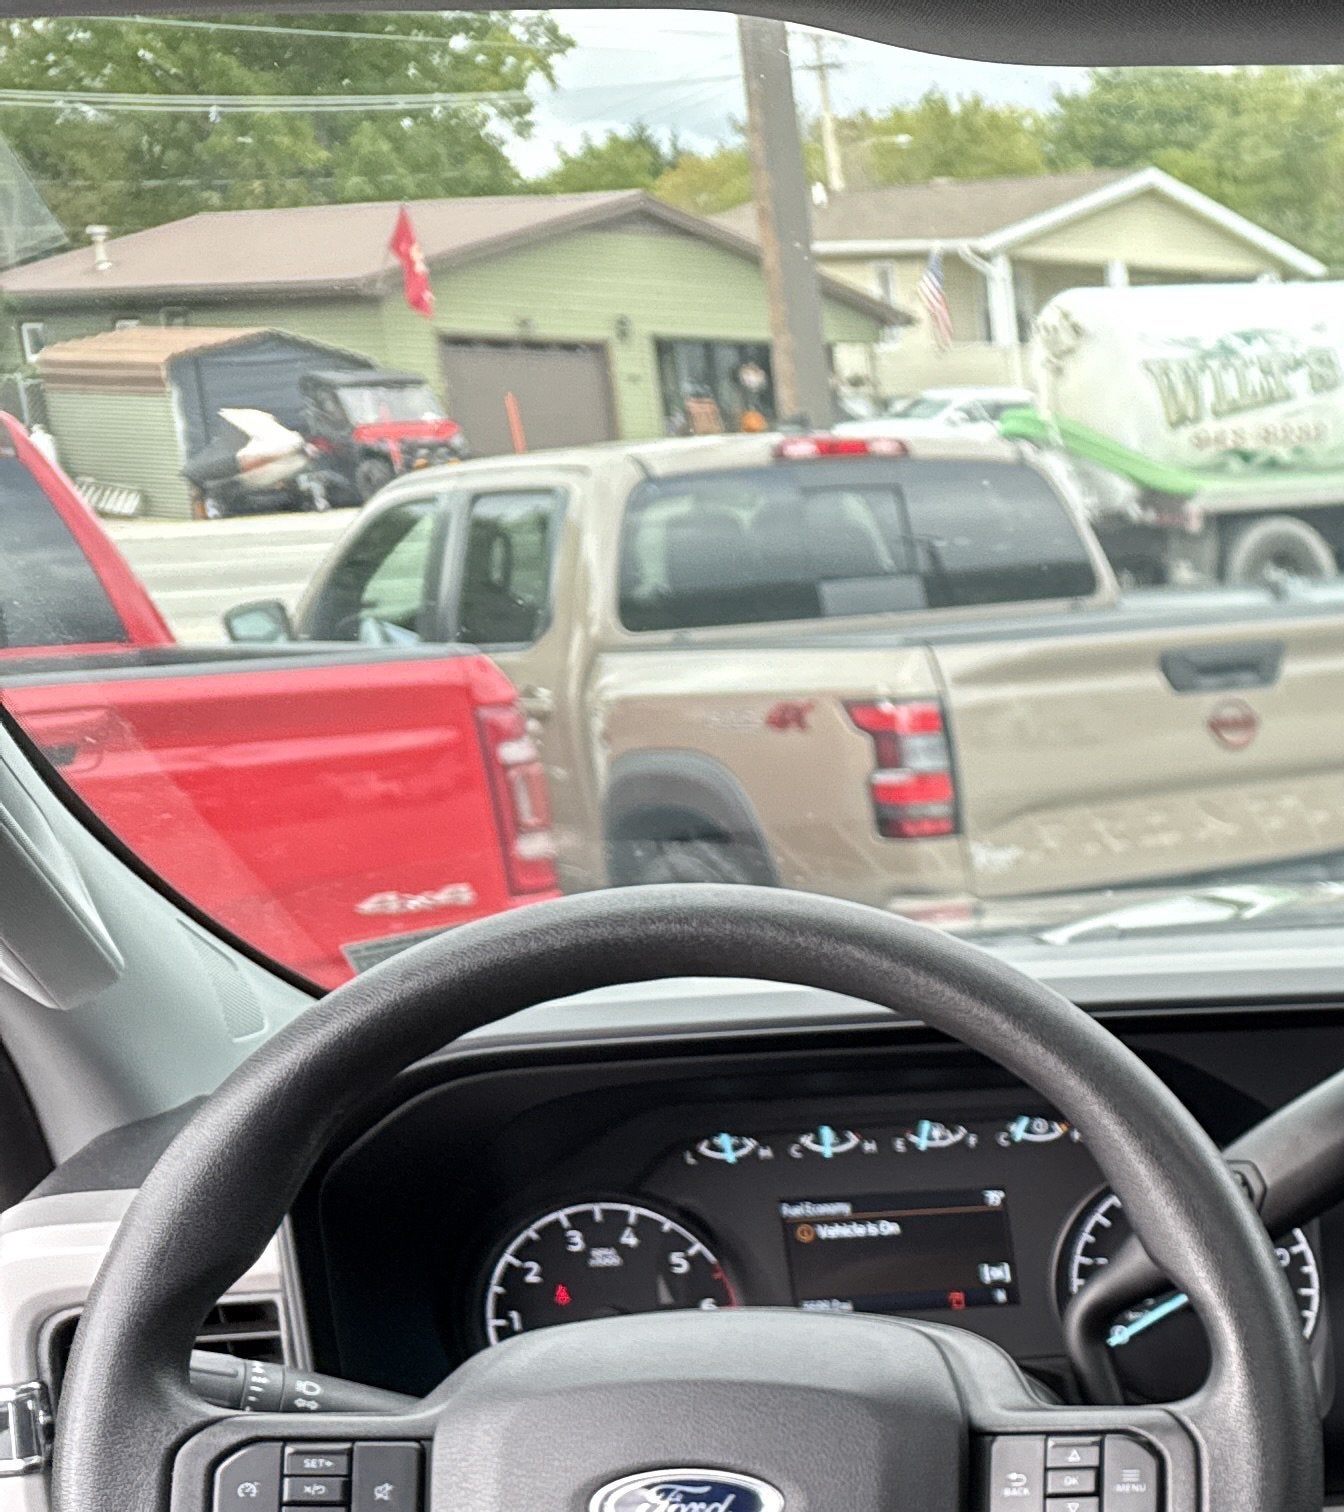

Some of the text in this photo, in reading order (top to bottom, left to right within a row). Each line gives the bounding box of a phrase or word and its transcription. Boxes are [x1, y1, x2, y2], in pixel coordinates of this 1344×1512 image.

[565, 1229, 586, 1252] 3
[620, 1227, 640, 1248] 4
[522, 1261, 543, 1284] 2
[669, 1251, 690, 1274] 5
[509, 1310, 523, 1331] 1
[1063, 1475, 1079, 1487] OK
[1115, 1483, 1147, 1494] MENU
[1003, 1487, 1030, 1498] BACK
